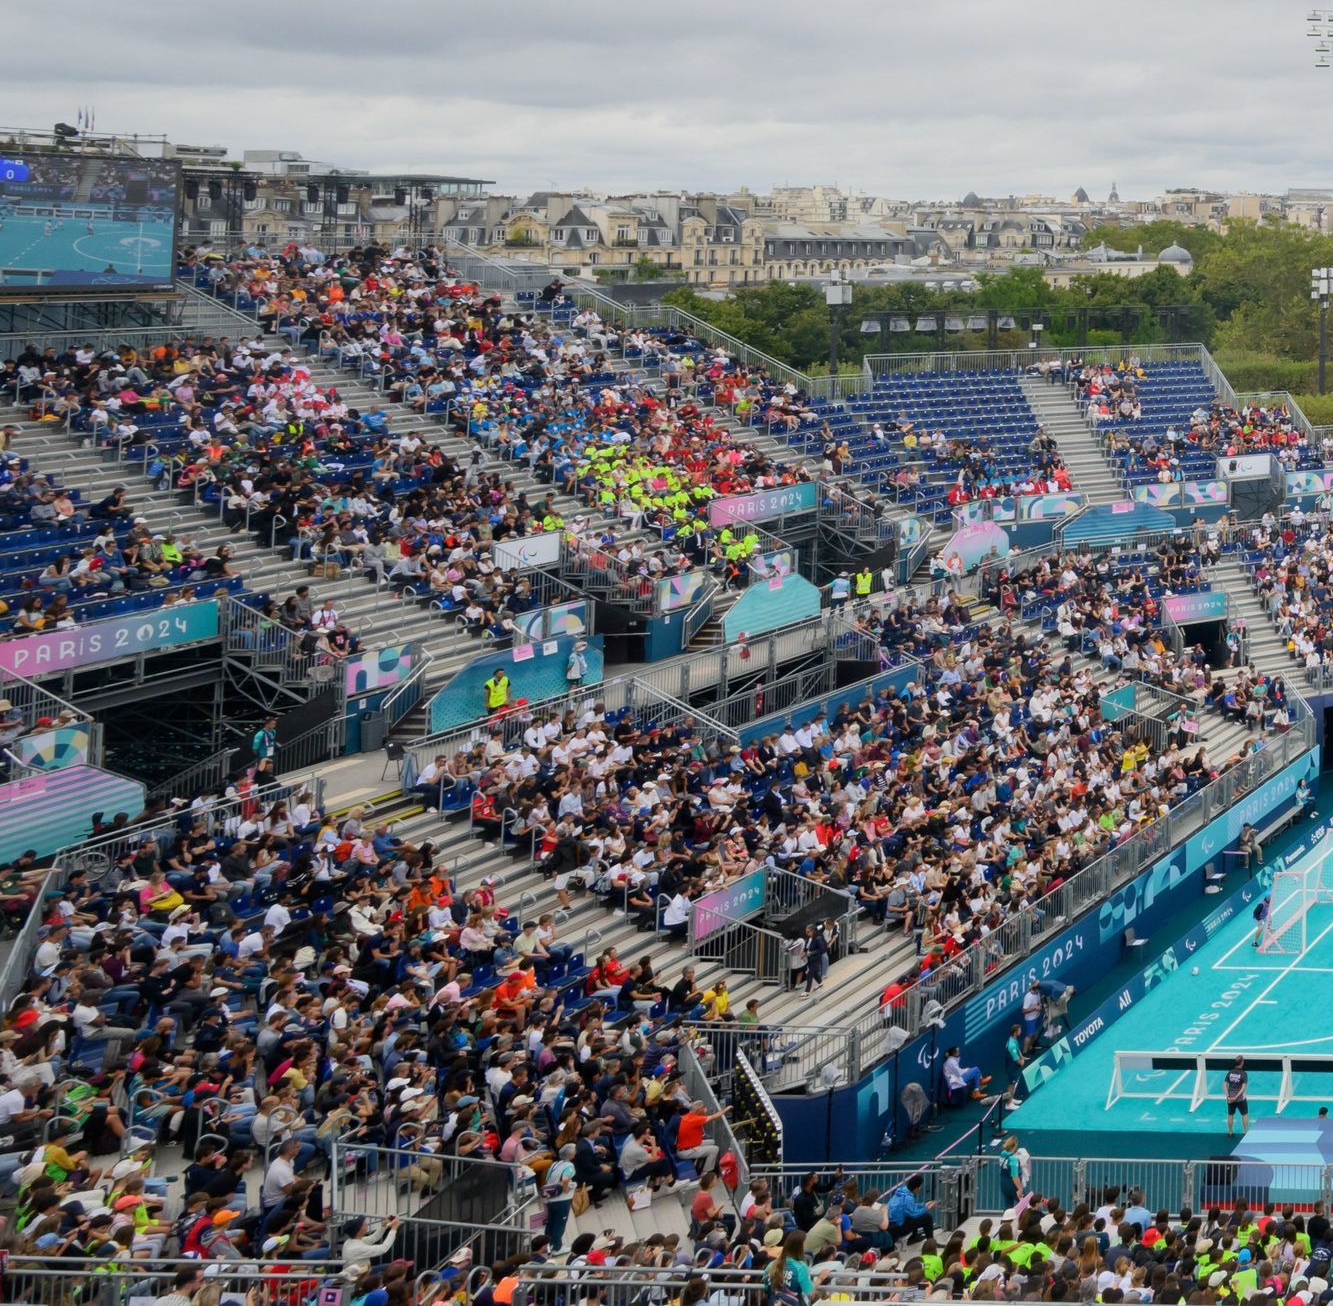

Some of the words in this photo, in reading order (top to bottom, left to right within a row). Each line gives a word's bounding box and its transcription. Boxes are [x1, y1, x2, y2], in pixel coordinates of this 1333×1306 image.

[6, 170, 14, 180] 0
[729, 500, 765, 516] PARIS
[770, 492, 802, 509] 2024
[1170, 604, 1195, 613] PARIS
[14, 634, 102, 669] PARIS
[115, 617, 187, 648] 2024
[733, 886, 760, 907] 2024
[986, 966, 1036, 1020] PARIS
[1042, 935, 1084, 979] 2024
[1211, 974, 1260, 1008] 2024
[1073, 1016, 1104, 1047] TOYOTA
